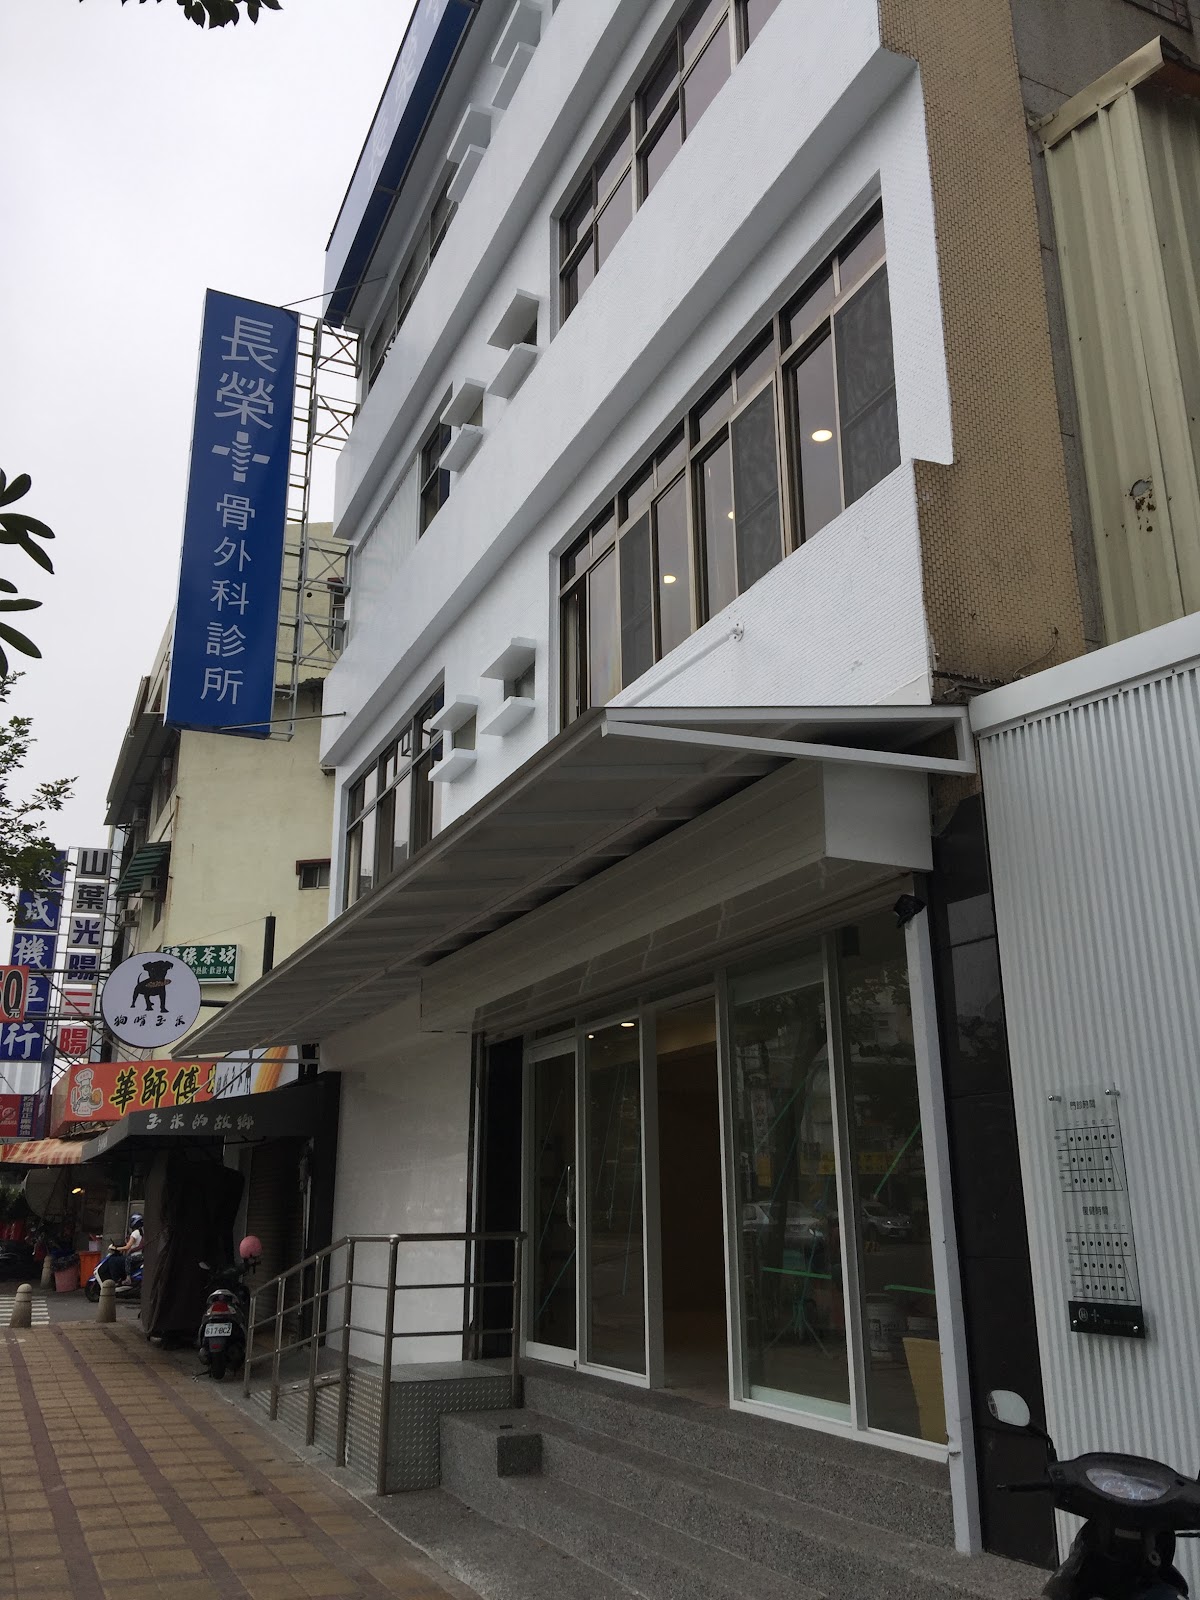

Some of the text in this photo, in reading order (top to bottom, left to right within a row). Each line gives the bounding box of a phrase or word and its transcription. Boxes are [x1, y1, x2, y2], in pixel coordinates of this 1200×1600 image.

[200, 315, 278, 706] 長榮 骨外科診所
[146, 1112, 255, 1131] 玉米的故鄉
